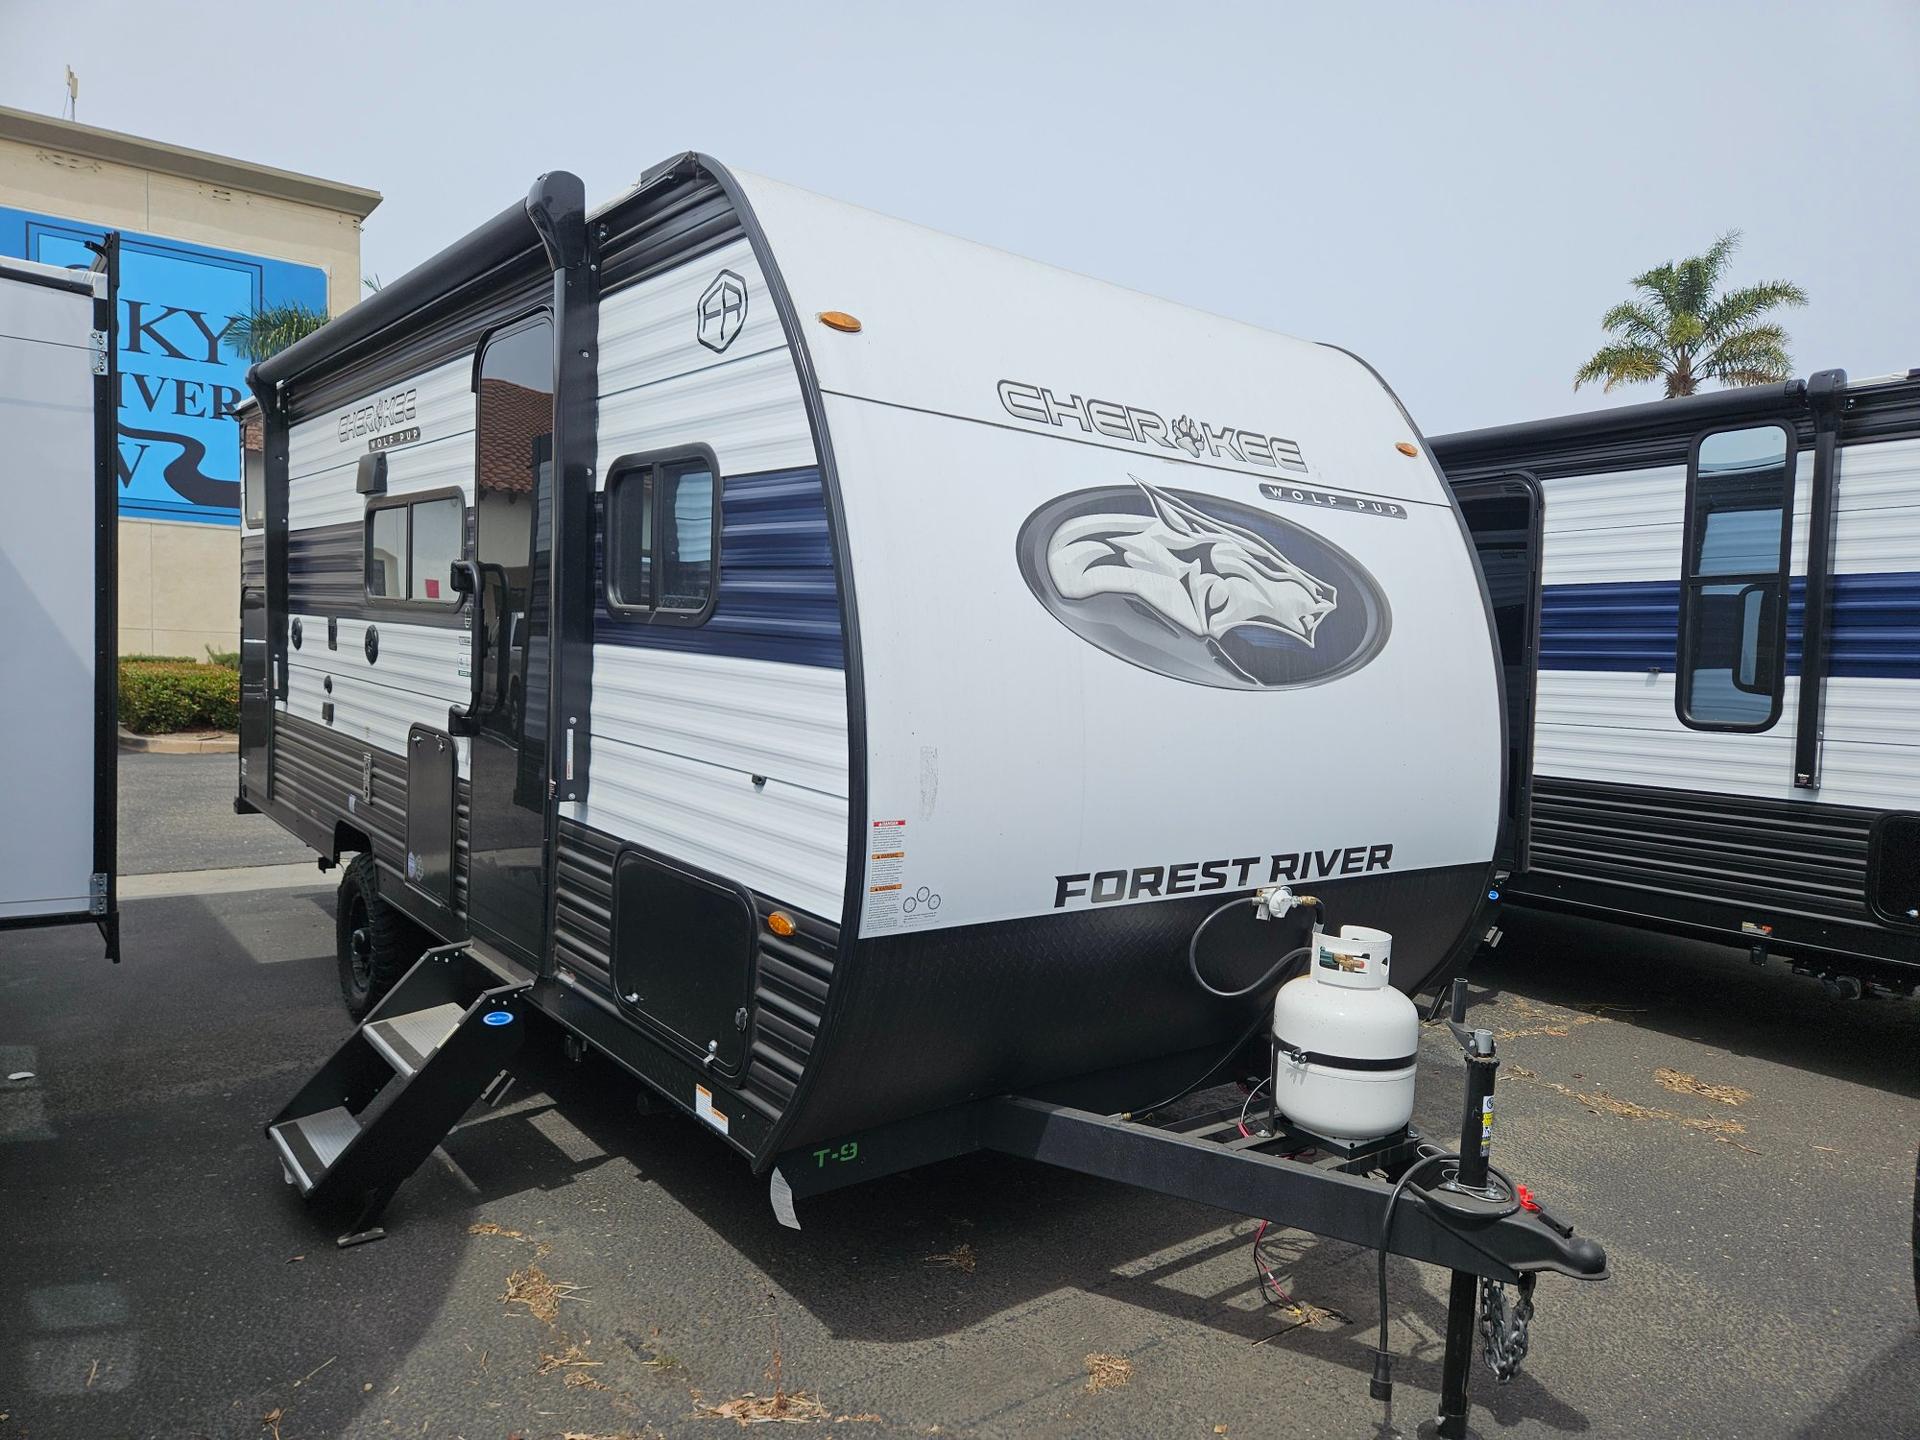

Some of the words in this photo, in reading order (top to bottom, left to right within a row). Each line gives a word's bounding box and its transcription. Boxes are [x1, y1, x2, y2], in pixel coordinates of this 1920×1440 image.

[117, 298, 242, 366] KY
[371, 434, 394, 449] WOLF
[400, 429, 418, 441] PUP
[1268, 485, 1337, 506] WOLF
[1356, 499, 1398, 515] PUP
[1053, 856, 1261, 908] FOREST
[1269, 843, 1394, 883] RIVER
